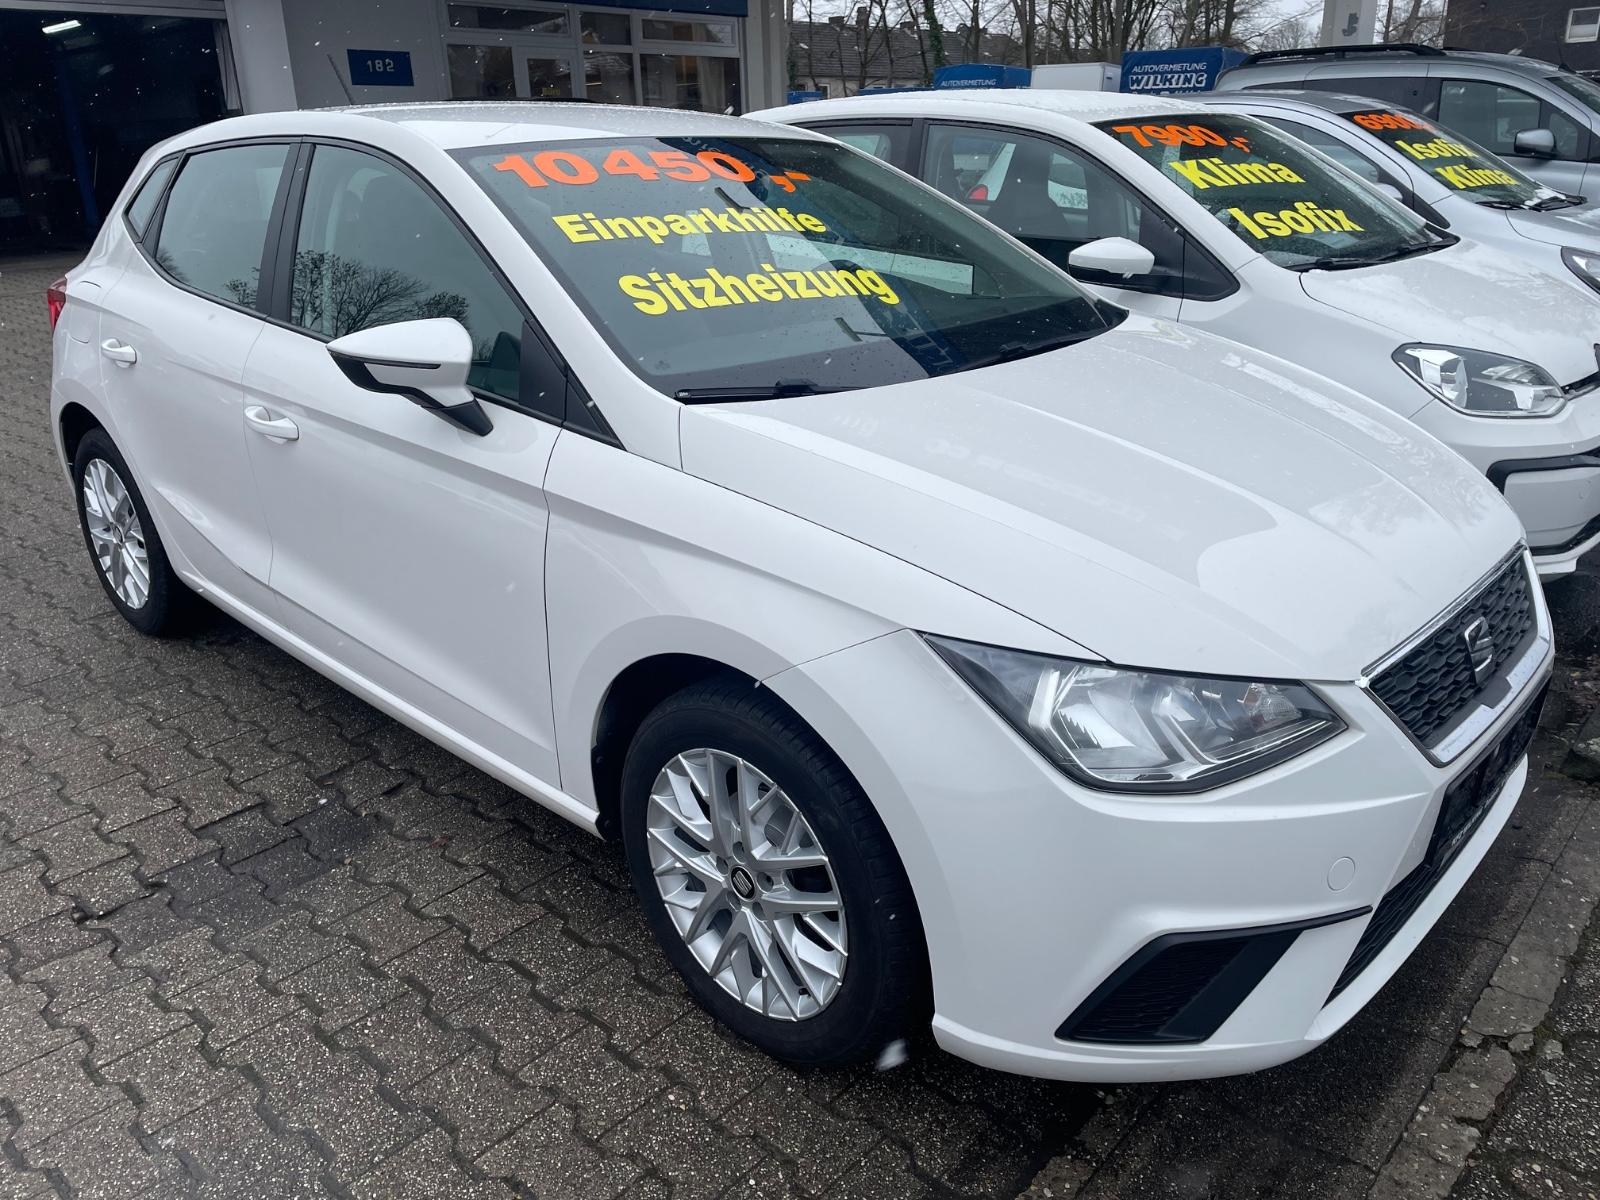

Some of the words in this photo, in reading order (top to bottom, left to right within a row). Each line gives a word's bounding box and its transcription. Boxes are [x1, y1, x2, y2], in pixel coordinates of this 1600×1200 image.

[367, 59, 394, 73] 182
[1131, 62, 1207, 73] AUTOVERMIETUNG
[1129, 72, 1207, 90] WILKING
[1169, 157, 1306, 189] Klima
[1435, 164, 1520, 189] Klima
[552, 207, 826, 244] Einparkhilfe
[1227, 201, 1365, 240] Isofix
[618, 264, 901, 315] Sitzheizung
